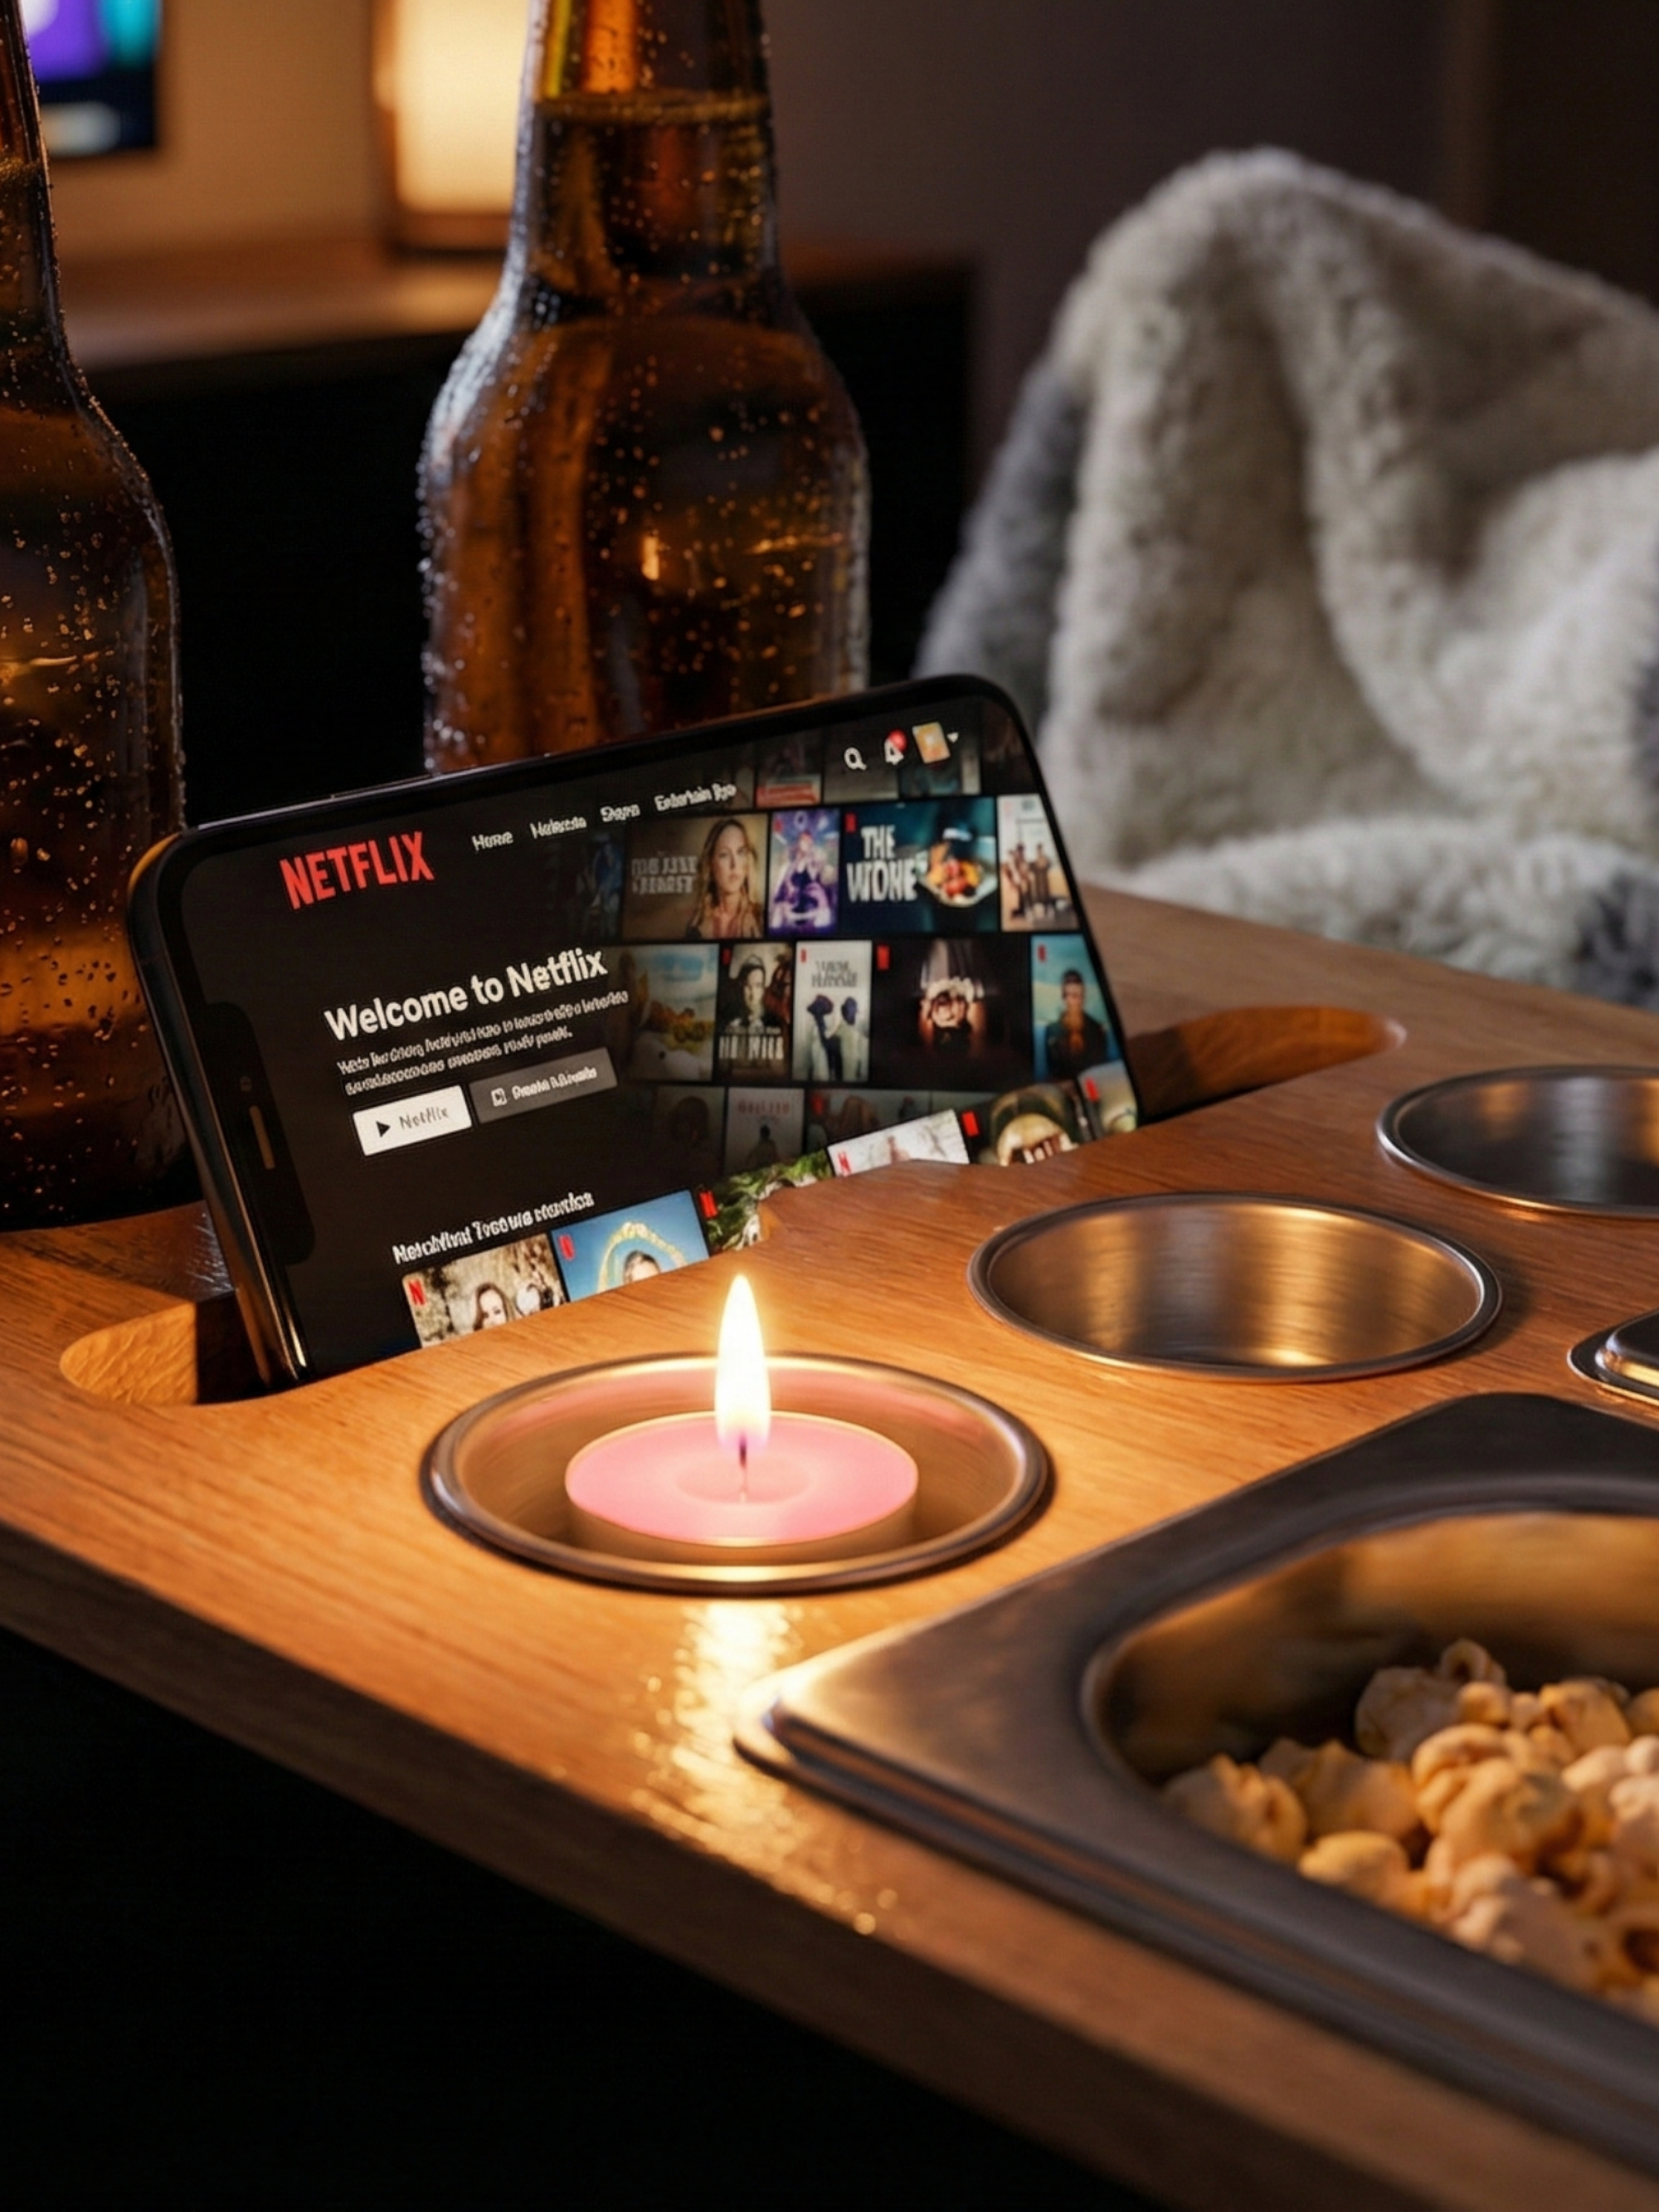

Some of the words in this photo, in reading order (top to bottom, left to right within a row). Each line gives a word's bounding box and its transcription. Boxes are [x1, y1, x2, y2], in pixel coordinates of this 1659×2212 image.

[278, 831, 435, 910] NETFLIX
[861, 825, 896, 860] THE
[324, 985, 469, 1041] Welcome
[470, 975, 505, 1006] to
[507, 947, 609, 997] Netflix
